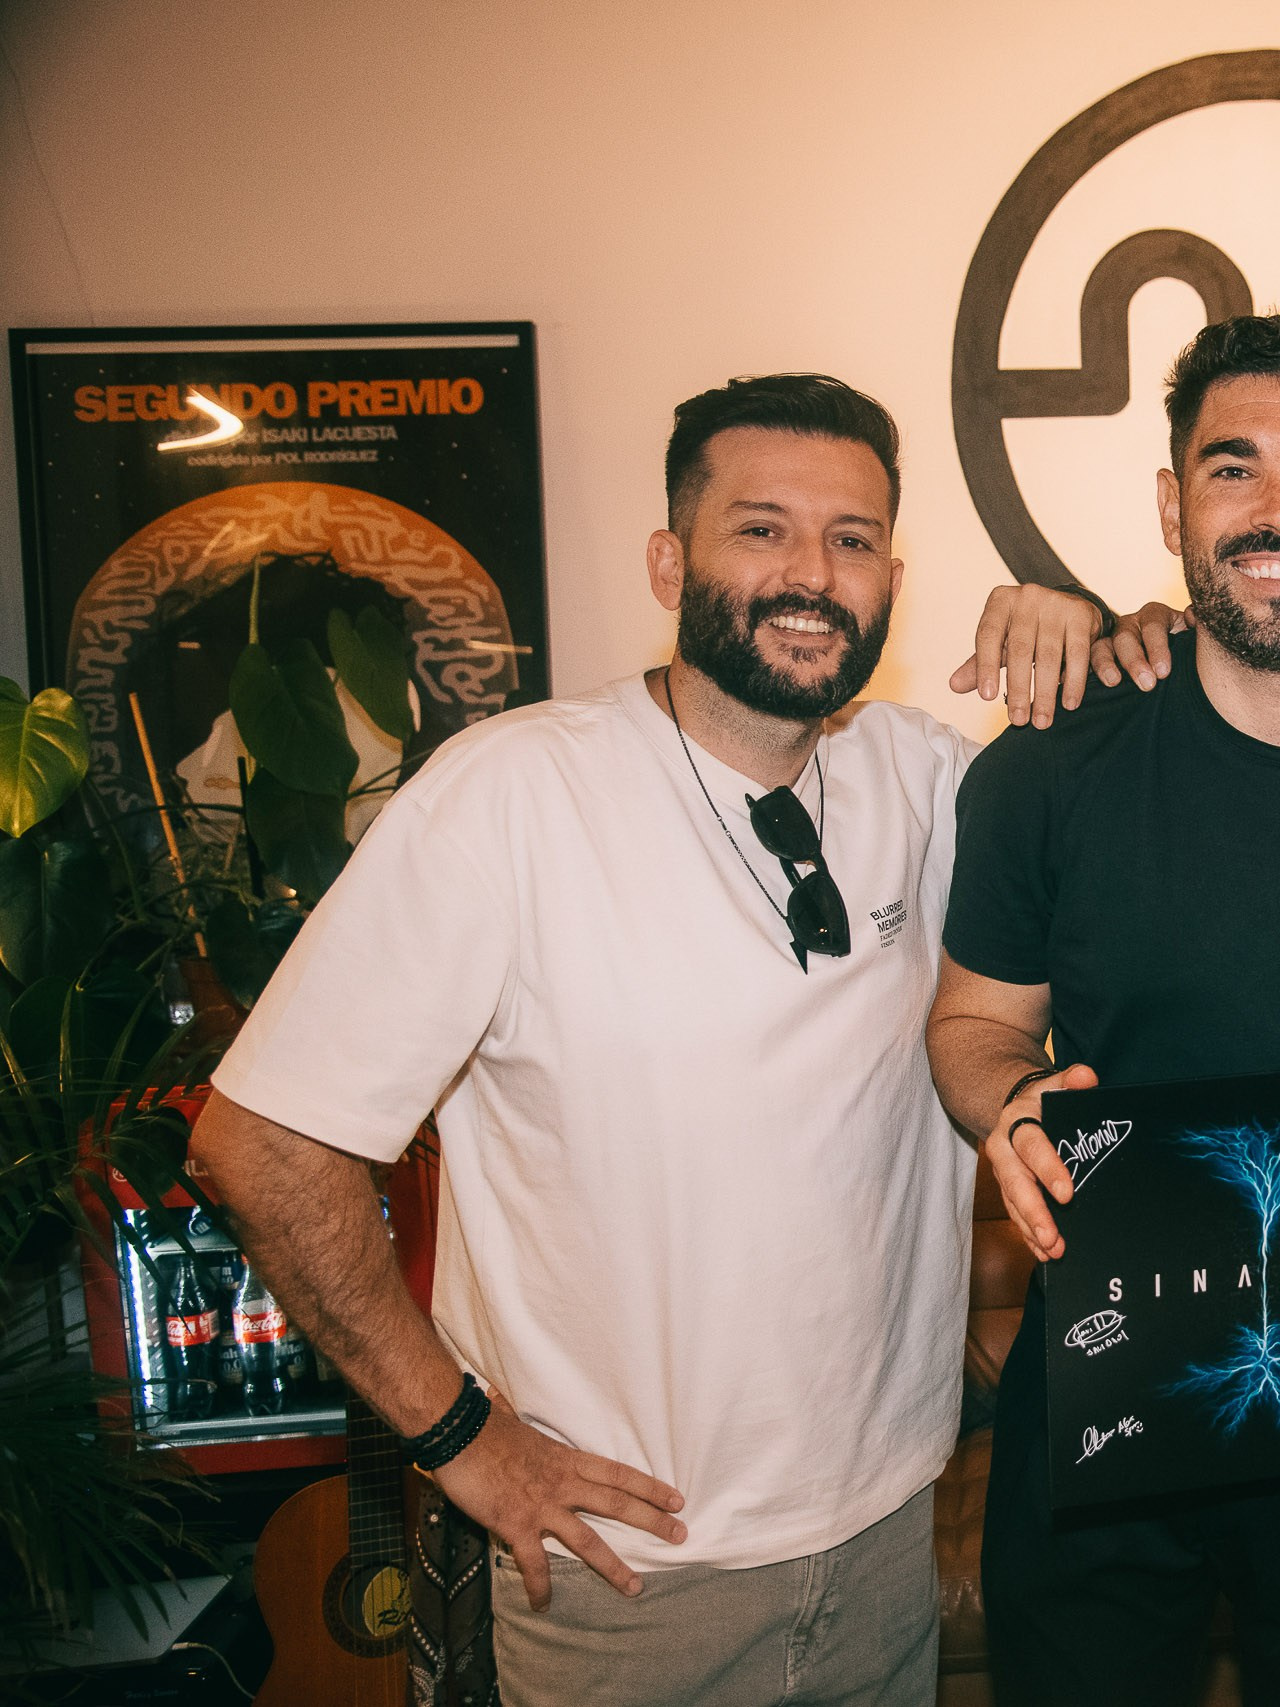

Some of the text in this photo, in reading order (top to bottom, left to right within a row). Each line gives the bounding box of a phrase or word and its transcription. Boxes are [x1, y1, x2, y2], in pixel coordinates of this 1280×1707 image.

[306, 377, 485, 418] PREMIO
[261, 427, 308, 443] ISAKI
[311, 423, 399, 442] LACUESTA
[274, 451, 302, 465] POL
[869, 899, 903, 920] BLURRED
[877, 910, 907, 933] MEMORIES
